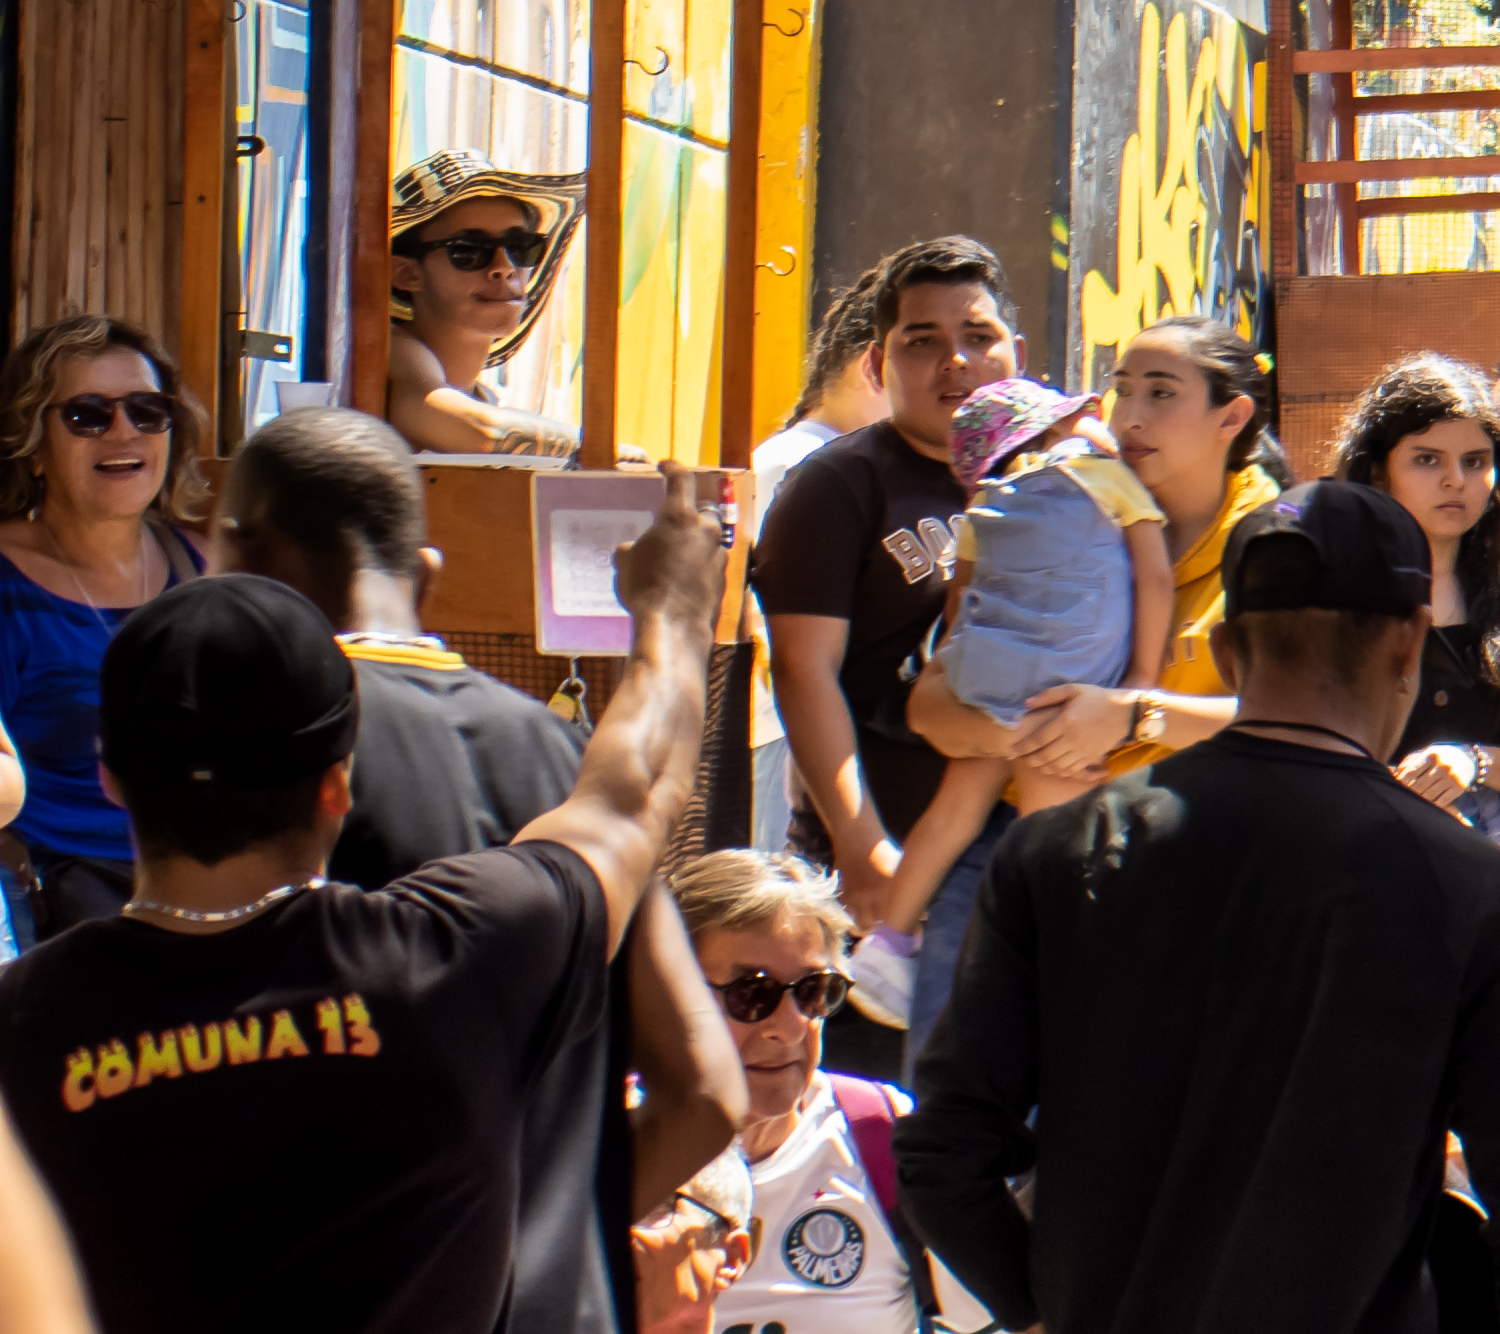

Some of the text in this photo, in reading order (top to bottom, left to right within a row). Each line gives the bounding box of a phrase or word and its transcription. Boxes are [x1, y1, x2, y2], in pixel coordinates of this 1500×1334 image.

[62, 991, 381, 1114] COMUNA 13
[787, 1241, 863, 1286] PALMEIRAS
